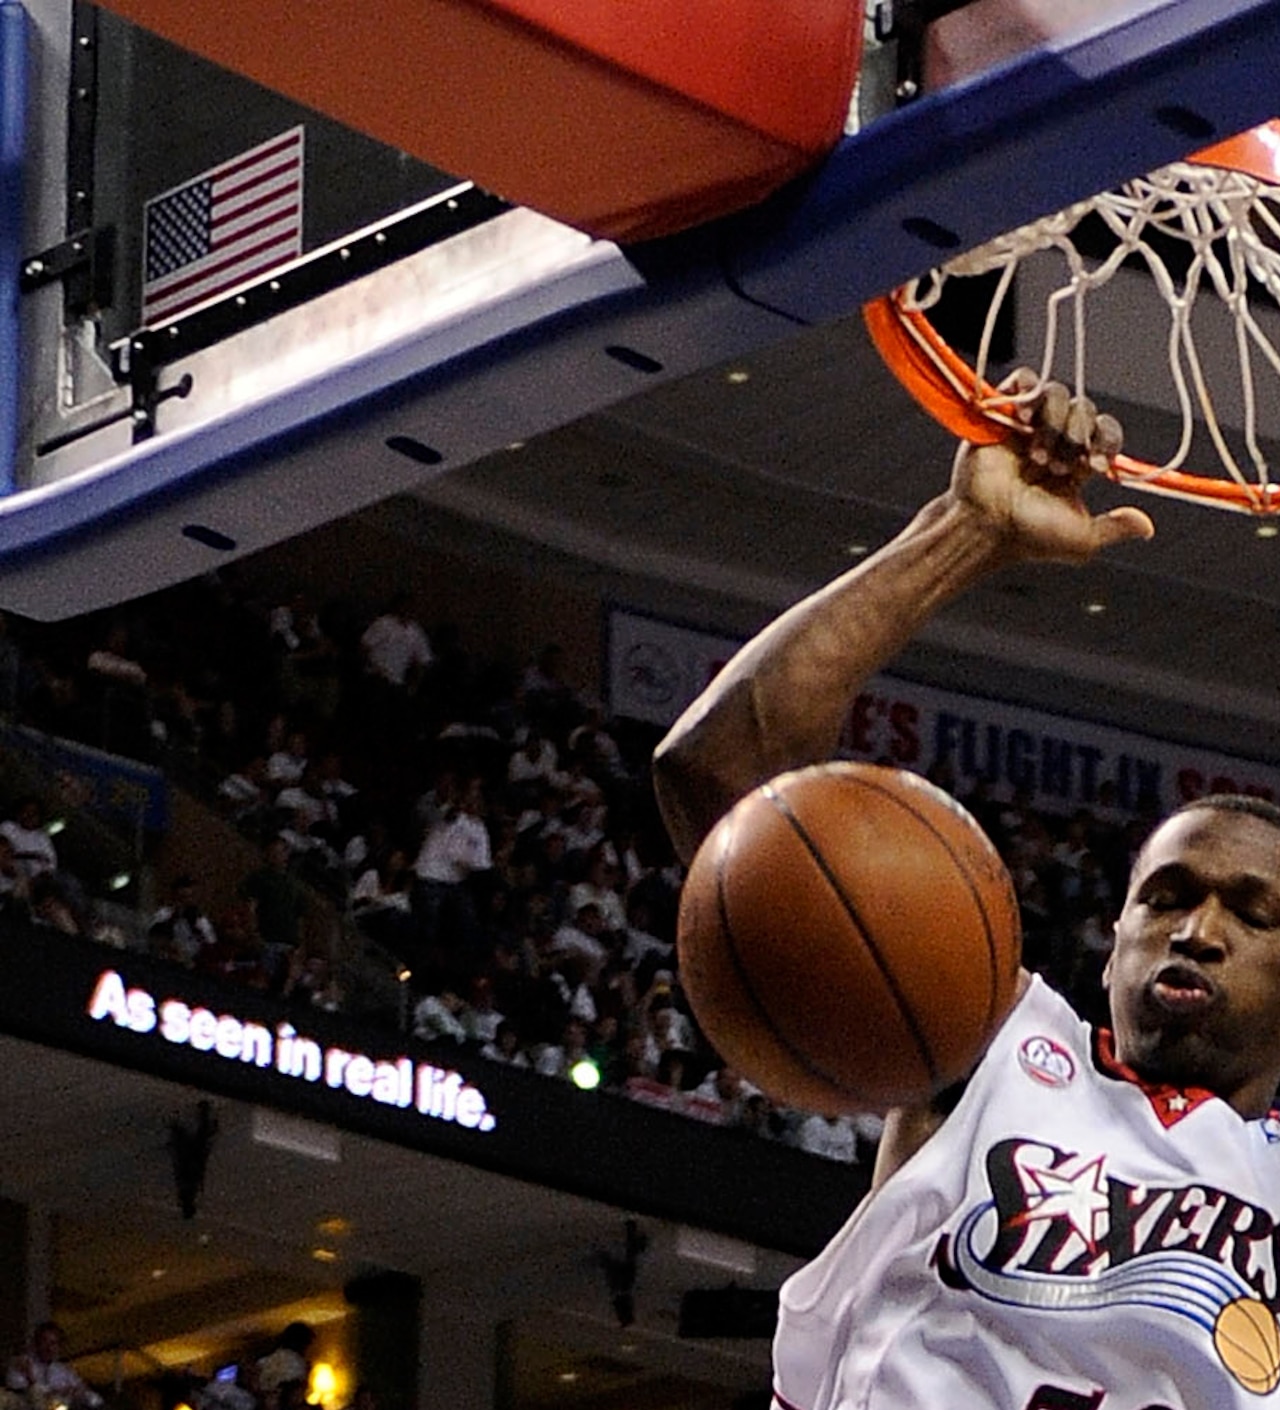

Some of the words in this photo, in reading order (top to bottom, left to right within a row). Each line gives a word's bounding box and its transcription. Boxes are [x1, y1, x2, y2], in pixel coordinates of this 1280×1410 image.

[90, 970, 156, 1033] As
[160, 1000, 272, 1067] seen
[277, 1022, 322, 1082] in
[325, 1047, 413, 1108] real
[416, 1062, 496, 1132] life.
